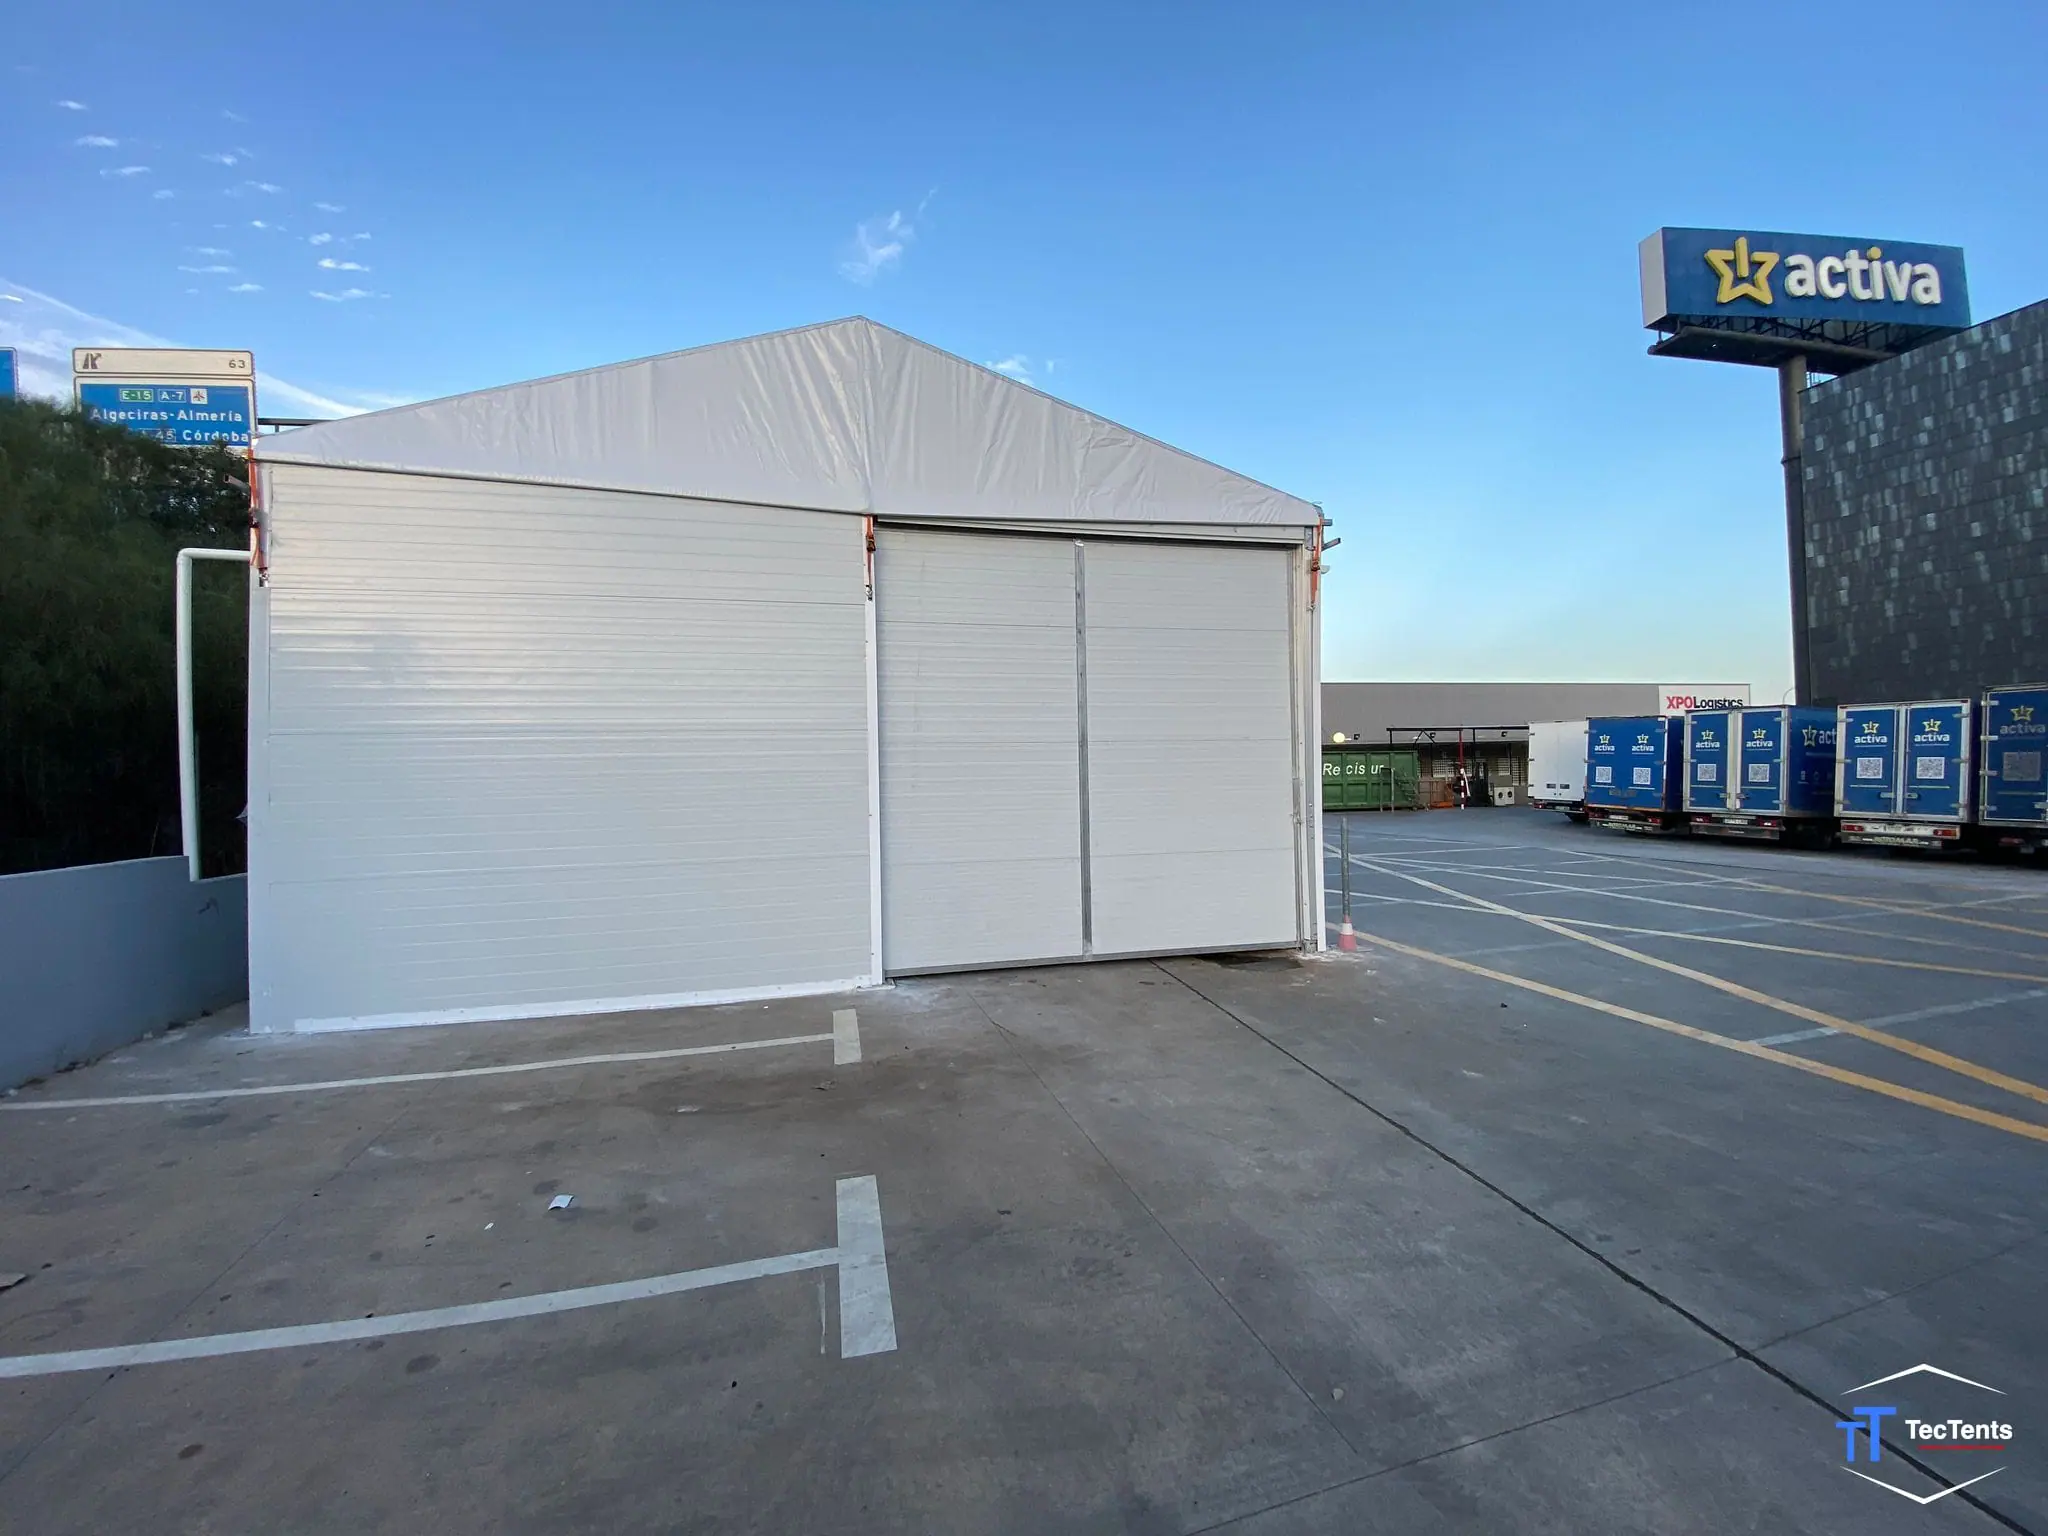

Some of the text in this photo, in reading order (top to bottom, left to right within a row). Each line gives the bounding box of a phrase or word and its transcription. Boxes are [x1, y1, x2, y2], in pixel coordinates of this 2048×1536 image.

[1784, 246, 1942, 305] activa
[228, 359, 246, 369] 63
[122, 390, 151, 401] E-15
[160, 391, 184, 401] A-7
[182, 429, 249, 442] Córdoba
[2000, 722, 2047, 735] activa
[1746, 738, 1773, 748] activa
[1854, 734, 1889, 744] activa
[1914, 733, 1951, 743] activa
[1594, 743, 1615, 752] activa
[1632, 744, 1655, 752] activa
[1695, 740, 1721, 749] activa
